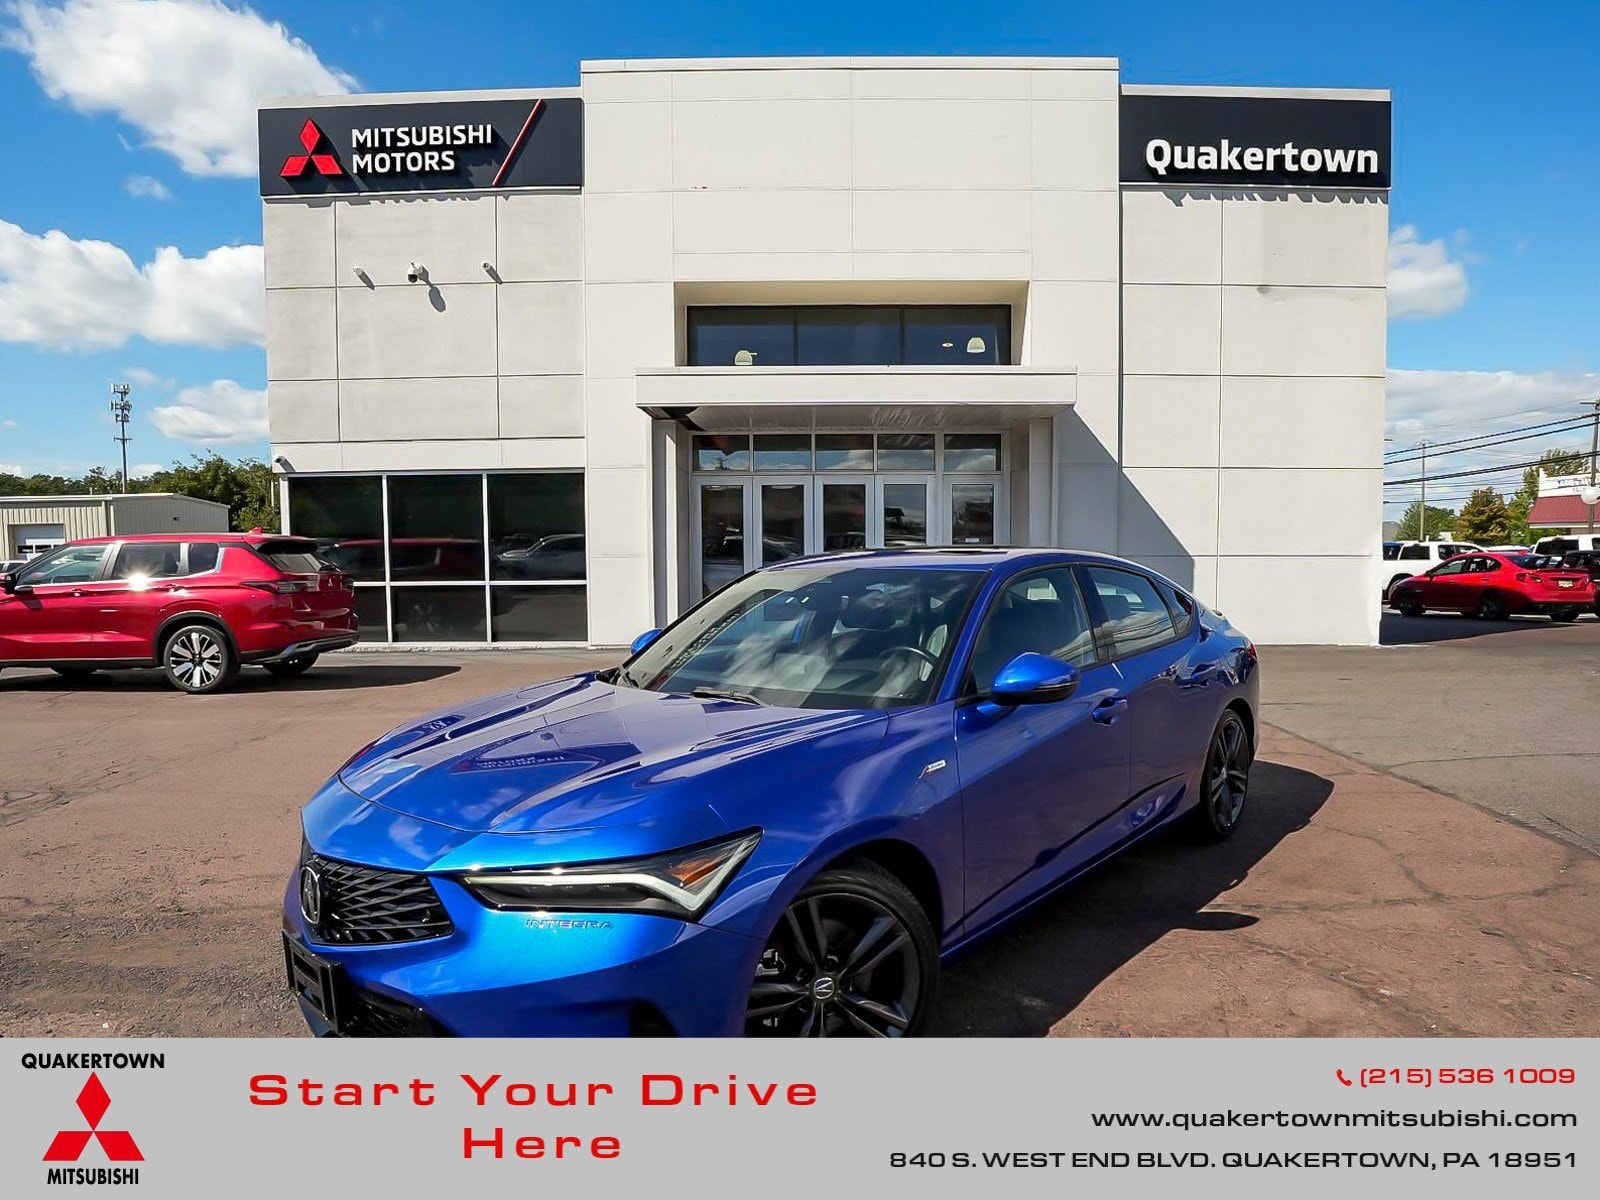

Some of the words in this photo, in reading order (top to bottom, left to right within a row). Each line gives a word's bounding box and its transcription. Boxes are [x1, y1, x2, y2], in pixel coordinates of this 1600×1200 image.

[351, 123, 493, 148] MITSUBISHI
[352, 150, 456, 174] MOTORS
[1145, 138, 1379, 176] Quakertown
[525, 919, 614, 929] INTEGRA
